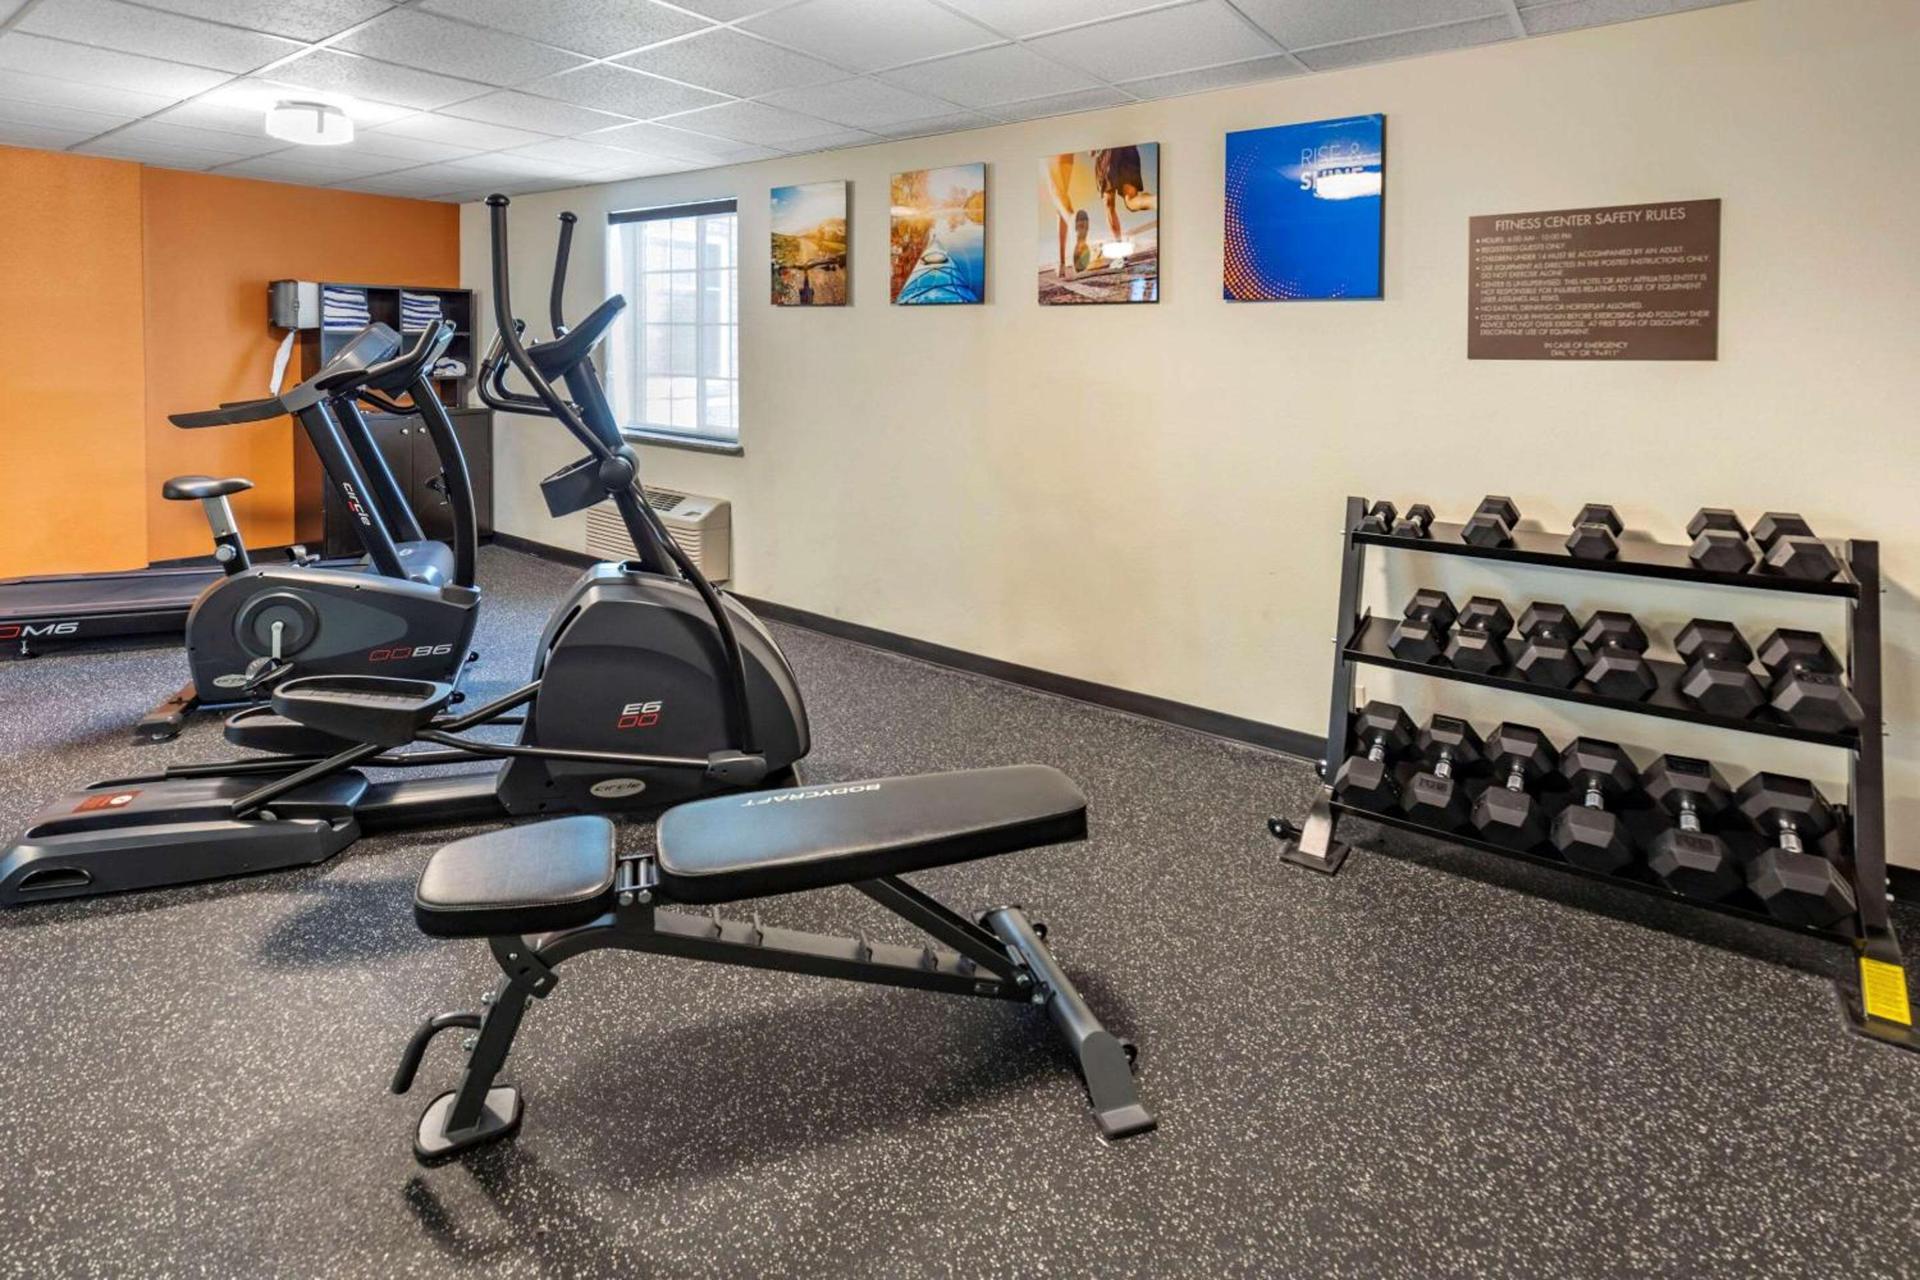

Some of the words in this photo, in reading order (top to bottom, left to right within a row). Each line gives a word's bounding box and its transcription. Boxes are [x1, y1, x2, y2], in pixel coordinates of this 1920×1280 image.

[1495, 218, 1541, 231] FITNESS
[1544, 215, 1591, 228] CENTER
[1595, 211, 1642, 225] SAFETY
[1646, 207, 1686, 220] RULES
[1631, 255, 1685, 265] INSTRUCTIONS
[740, 783, 881, 807] BODYCRAFT
